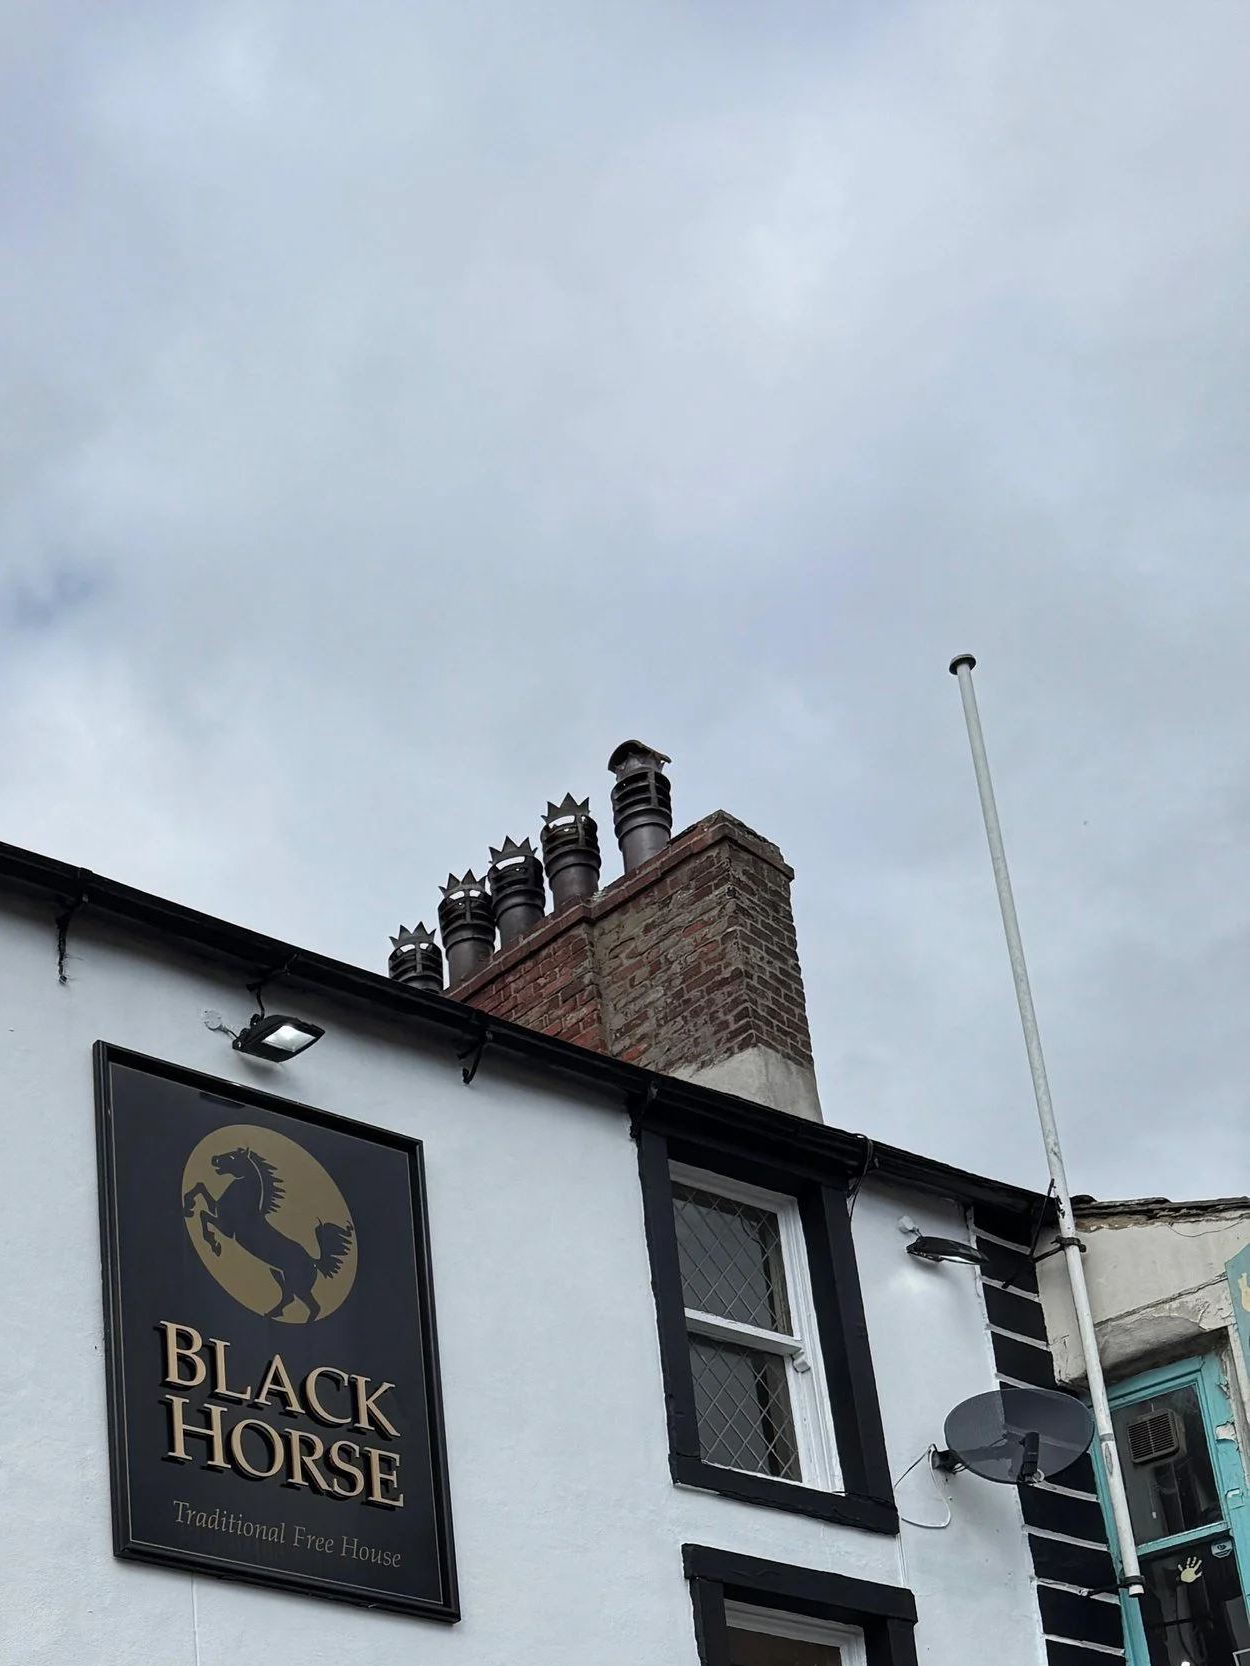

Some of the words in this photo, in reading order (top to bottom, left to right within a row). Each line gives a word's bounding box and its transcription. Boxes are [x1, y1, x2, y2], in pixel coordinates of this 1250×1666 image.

[159, 1320, 401, 1438] BLACK
[165, 1394, 406, 1508] HORSE
[173, 1500, 286, 1544] Traditional
[293, 1525, 335, 1554] Free
[340, 1535, 402, 1568] House
